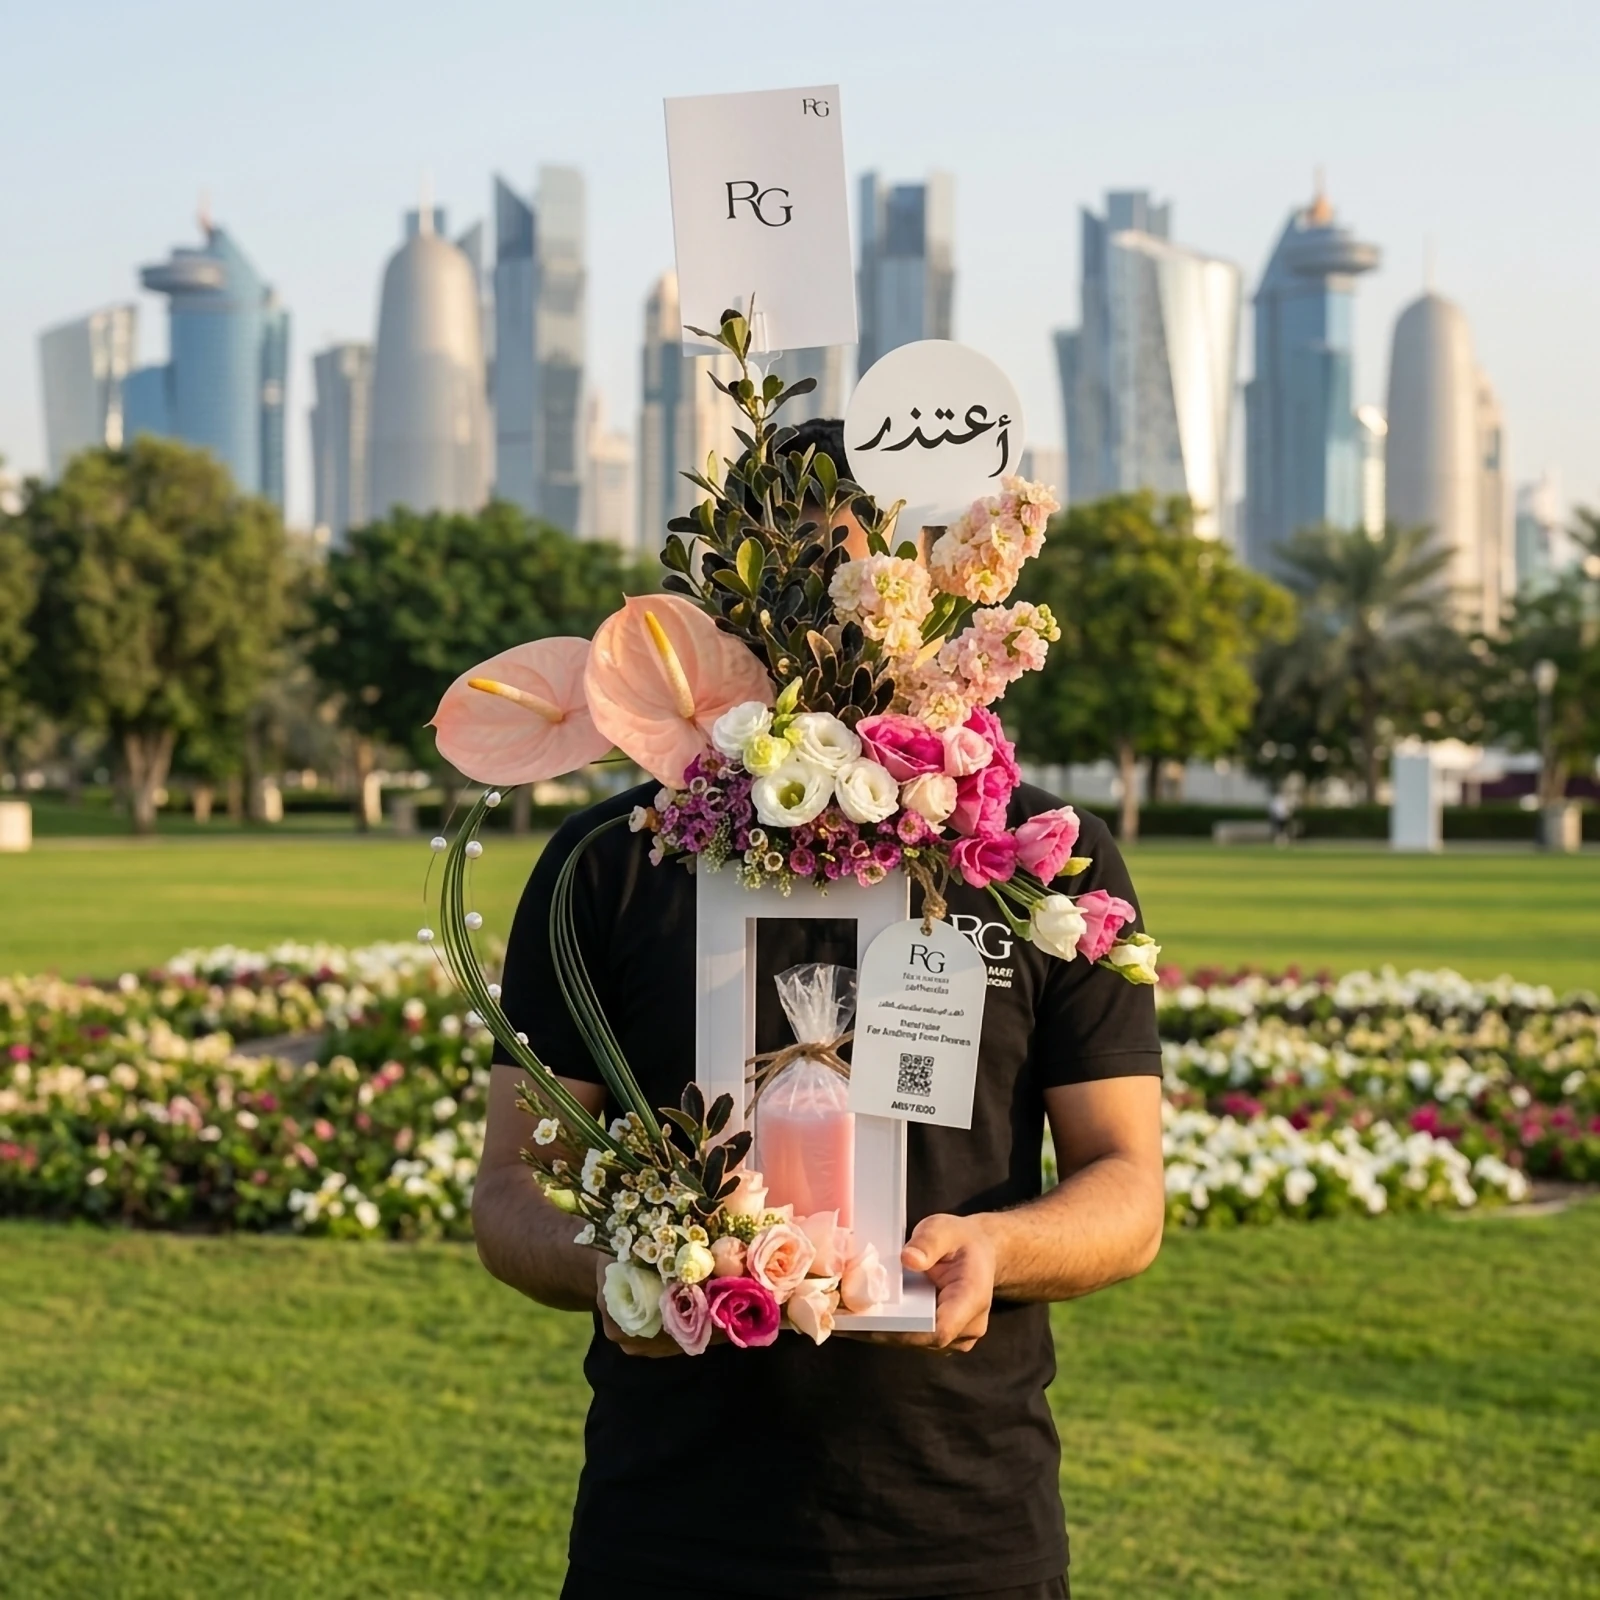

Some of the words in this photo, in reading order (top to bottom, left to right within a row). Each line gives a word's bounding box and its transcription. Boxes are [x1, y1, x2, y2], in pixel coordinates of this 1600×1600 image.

[802, 98, 829, 117] RG
[725, 180, 793, 227] RG
[854, 404, 1012, 478] أعتذر
[909, 943, 946, 974] RG
[949, 913, 1014, 960] RG
